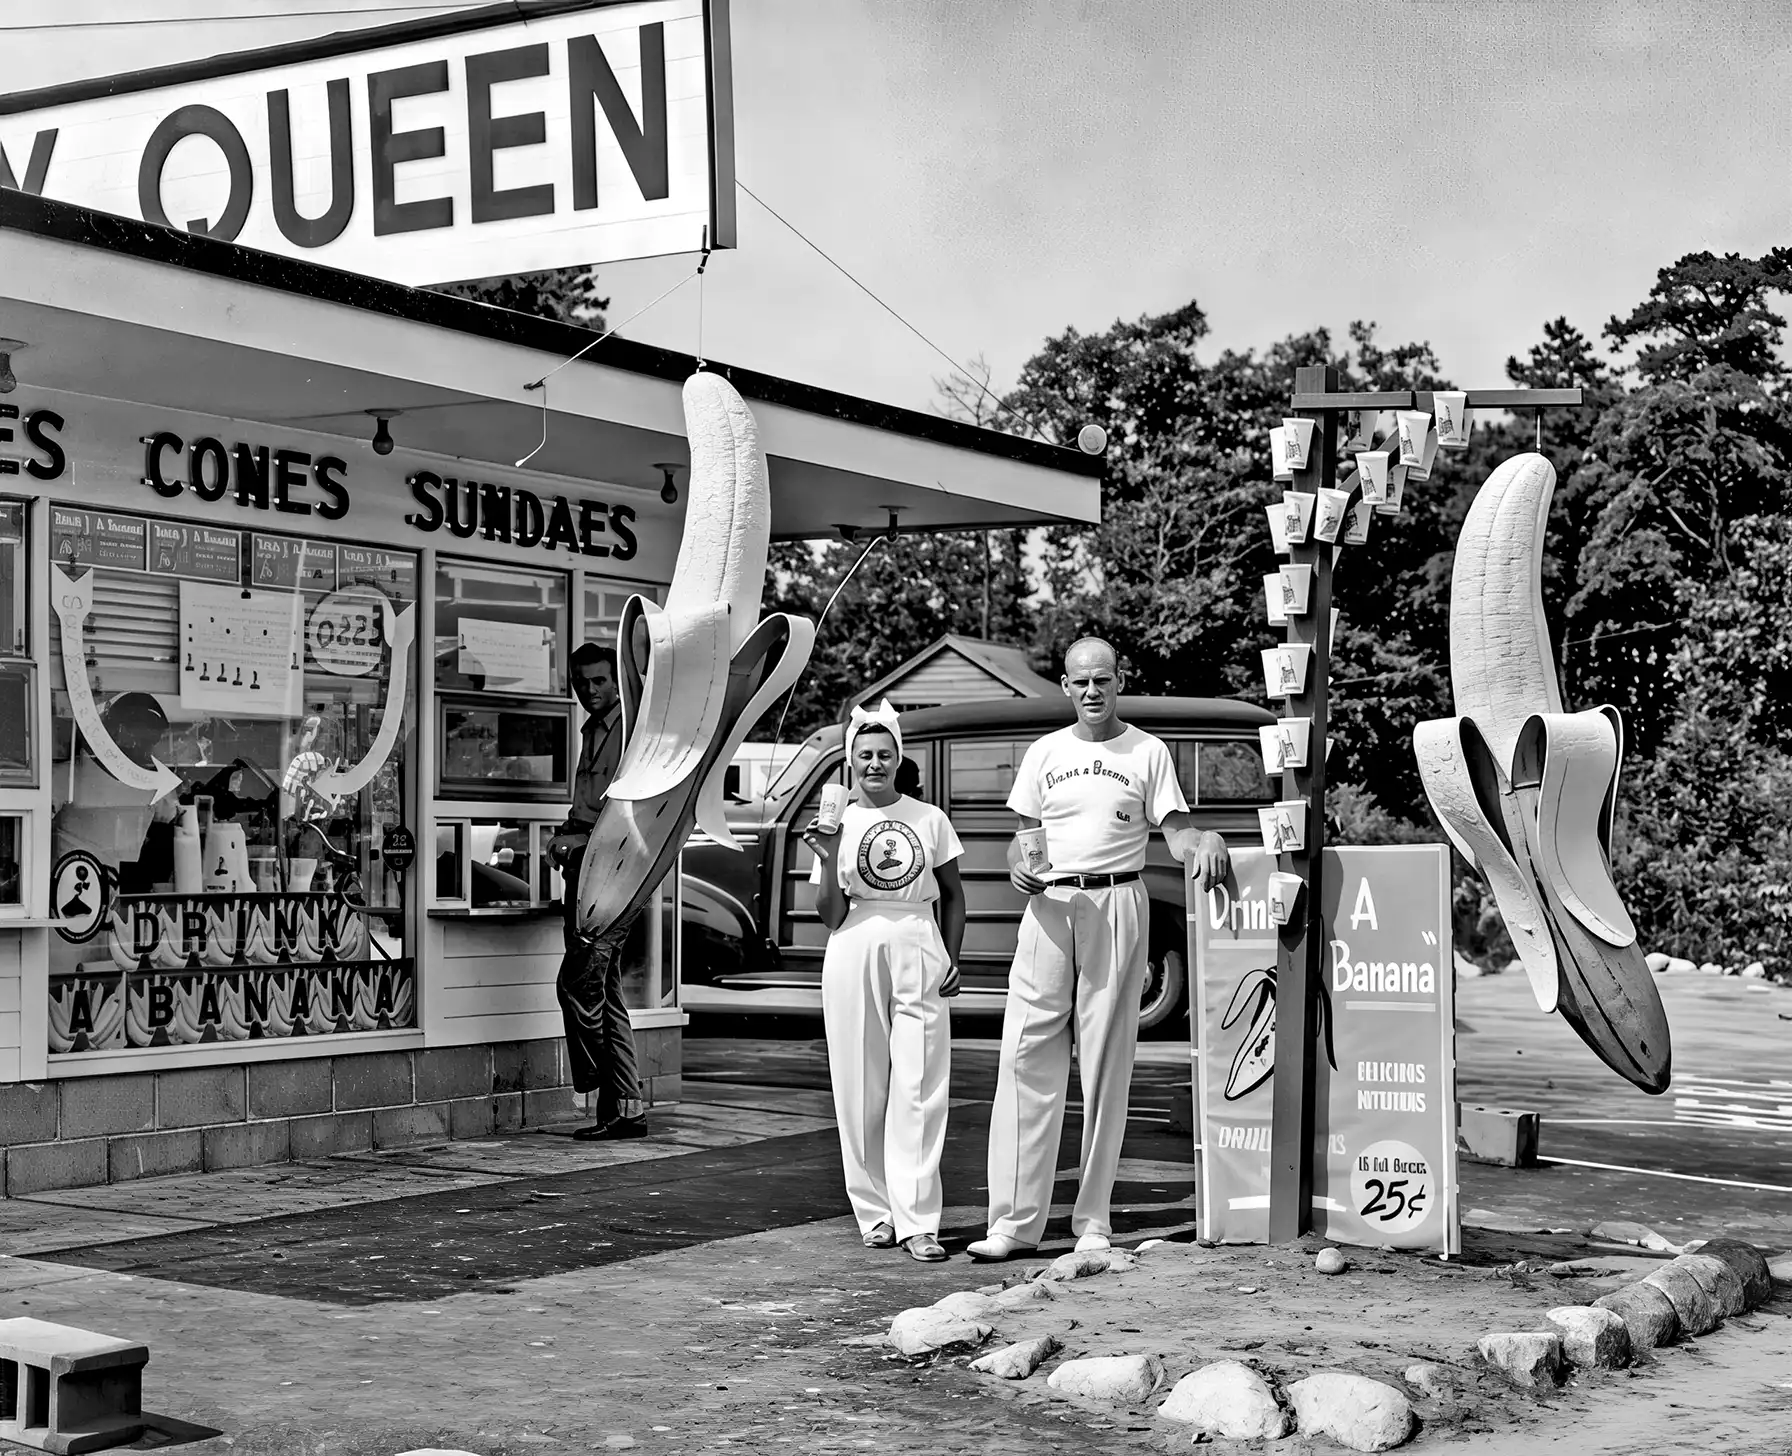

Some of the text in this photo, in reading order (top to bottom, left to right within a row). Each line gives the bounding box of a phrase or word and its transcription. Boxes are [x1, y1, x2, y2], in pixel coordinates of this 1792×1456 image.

[138, 21, 670, 249] QUEEN
[141, 431, 351, 520] CONES
[404, 470, 638, 561] SUNDAES
[133, 908, 340, 954] DRINK
[1208, 883, 1275, 931] Drin
[1350, 876, 1379, 931] A
[68, 973, 394, 1034] A BANANA
[1360, 1178, 1426, 1222] 25¢
